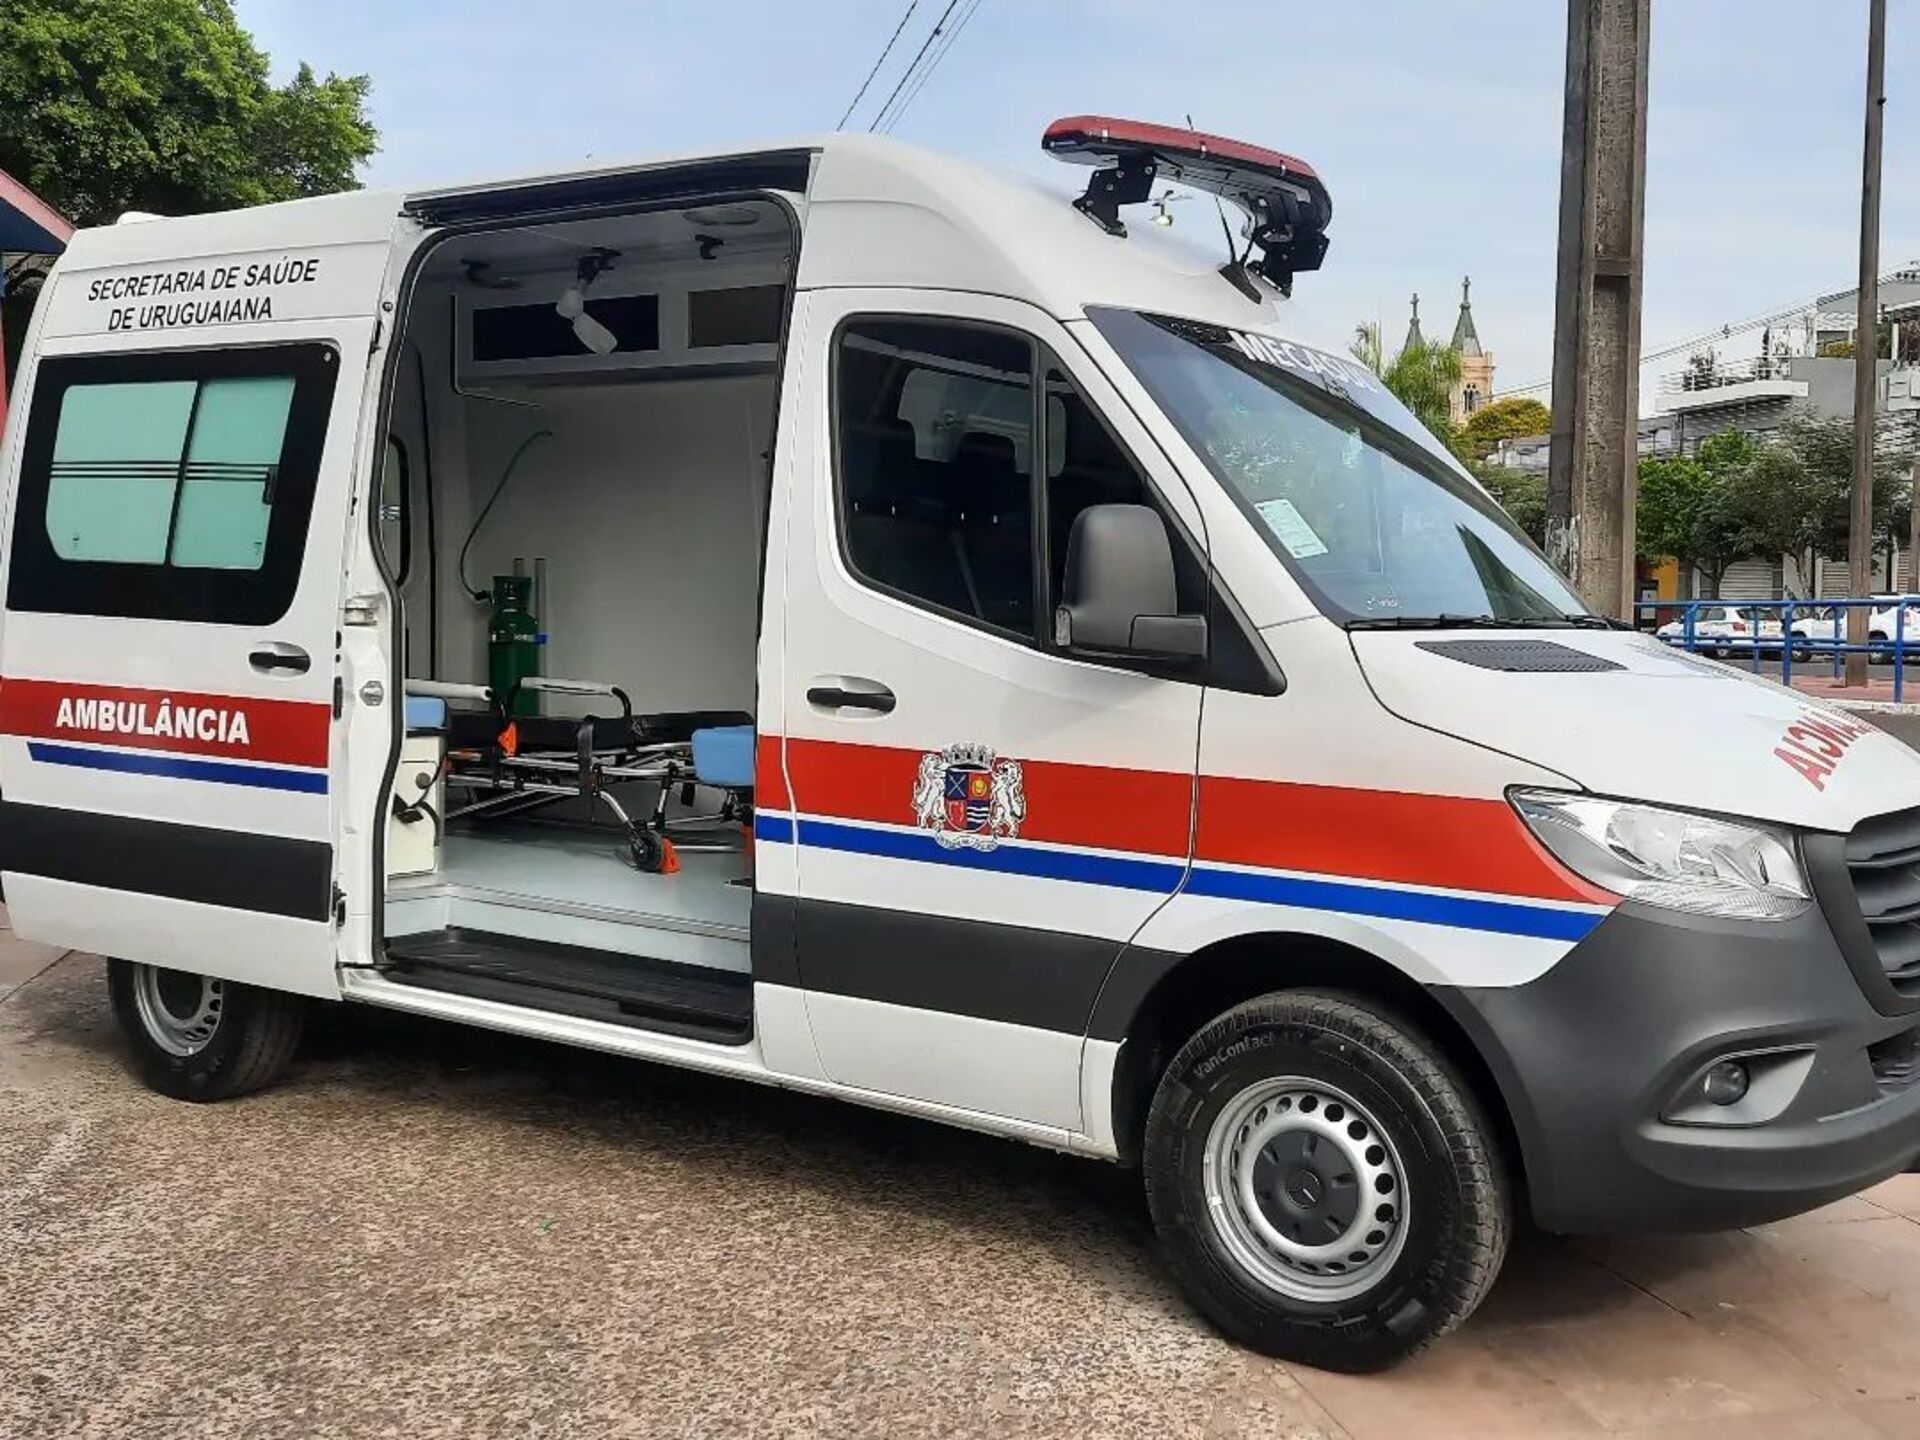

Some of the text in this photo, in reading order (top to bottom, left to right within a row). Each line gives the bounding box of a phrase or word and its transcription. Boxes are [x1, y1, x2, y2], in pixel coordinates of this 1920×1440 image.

[88, 255, 319, 301] SECRETARIA DE SAÚDE
[108, 296, 272, 331] DE URUGUAIANA
[55, 698, 249, 744] AMBULÂNCIA
